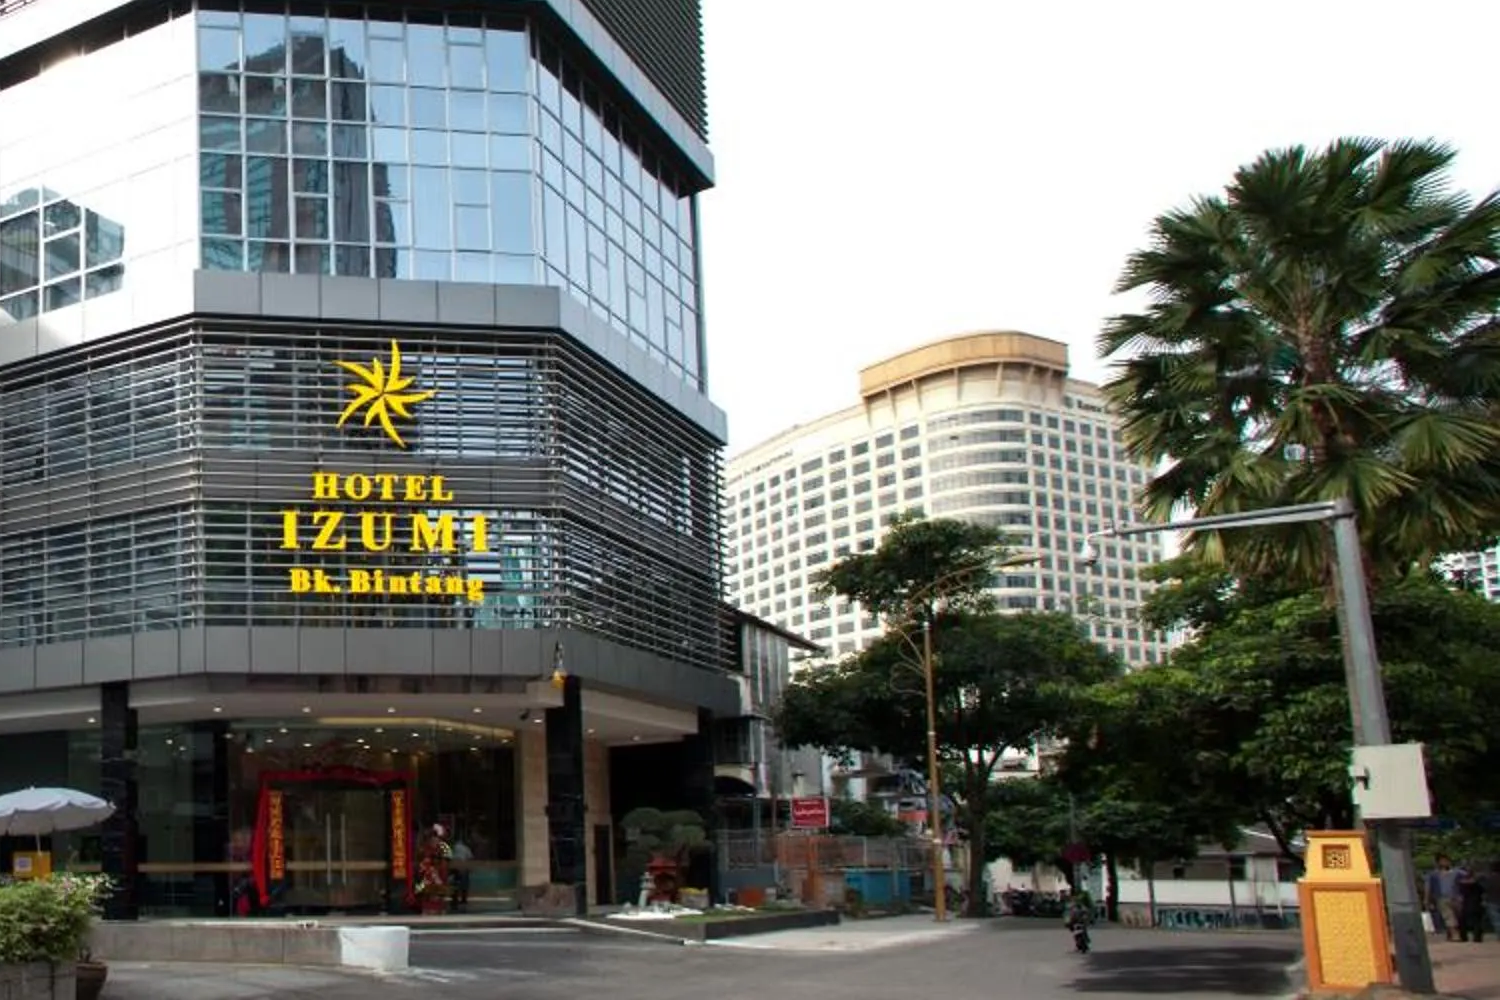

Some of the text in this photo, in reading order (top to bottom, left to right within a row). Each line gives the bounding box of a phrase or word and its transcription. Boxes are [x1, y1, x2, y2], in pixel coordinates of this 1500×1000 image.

[311, 472, 454, 501] HOTEL
[280, 510, 489, 553] IZUMI
[289, 567, 485, 602] Bk. Bintang
